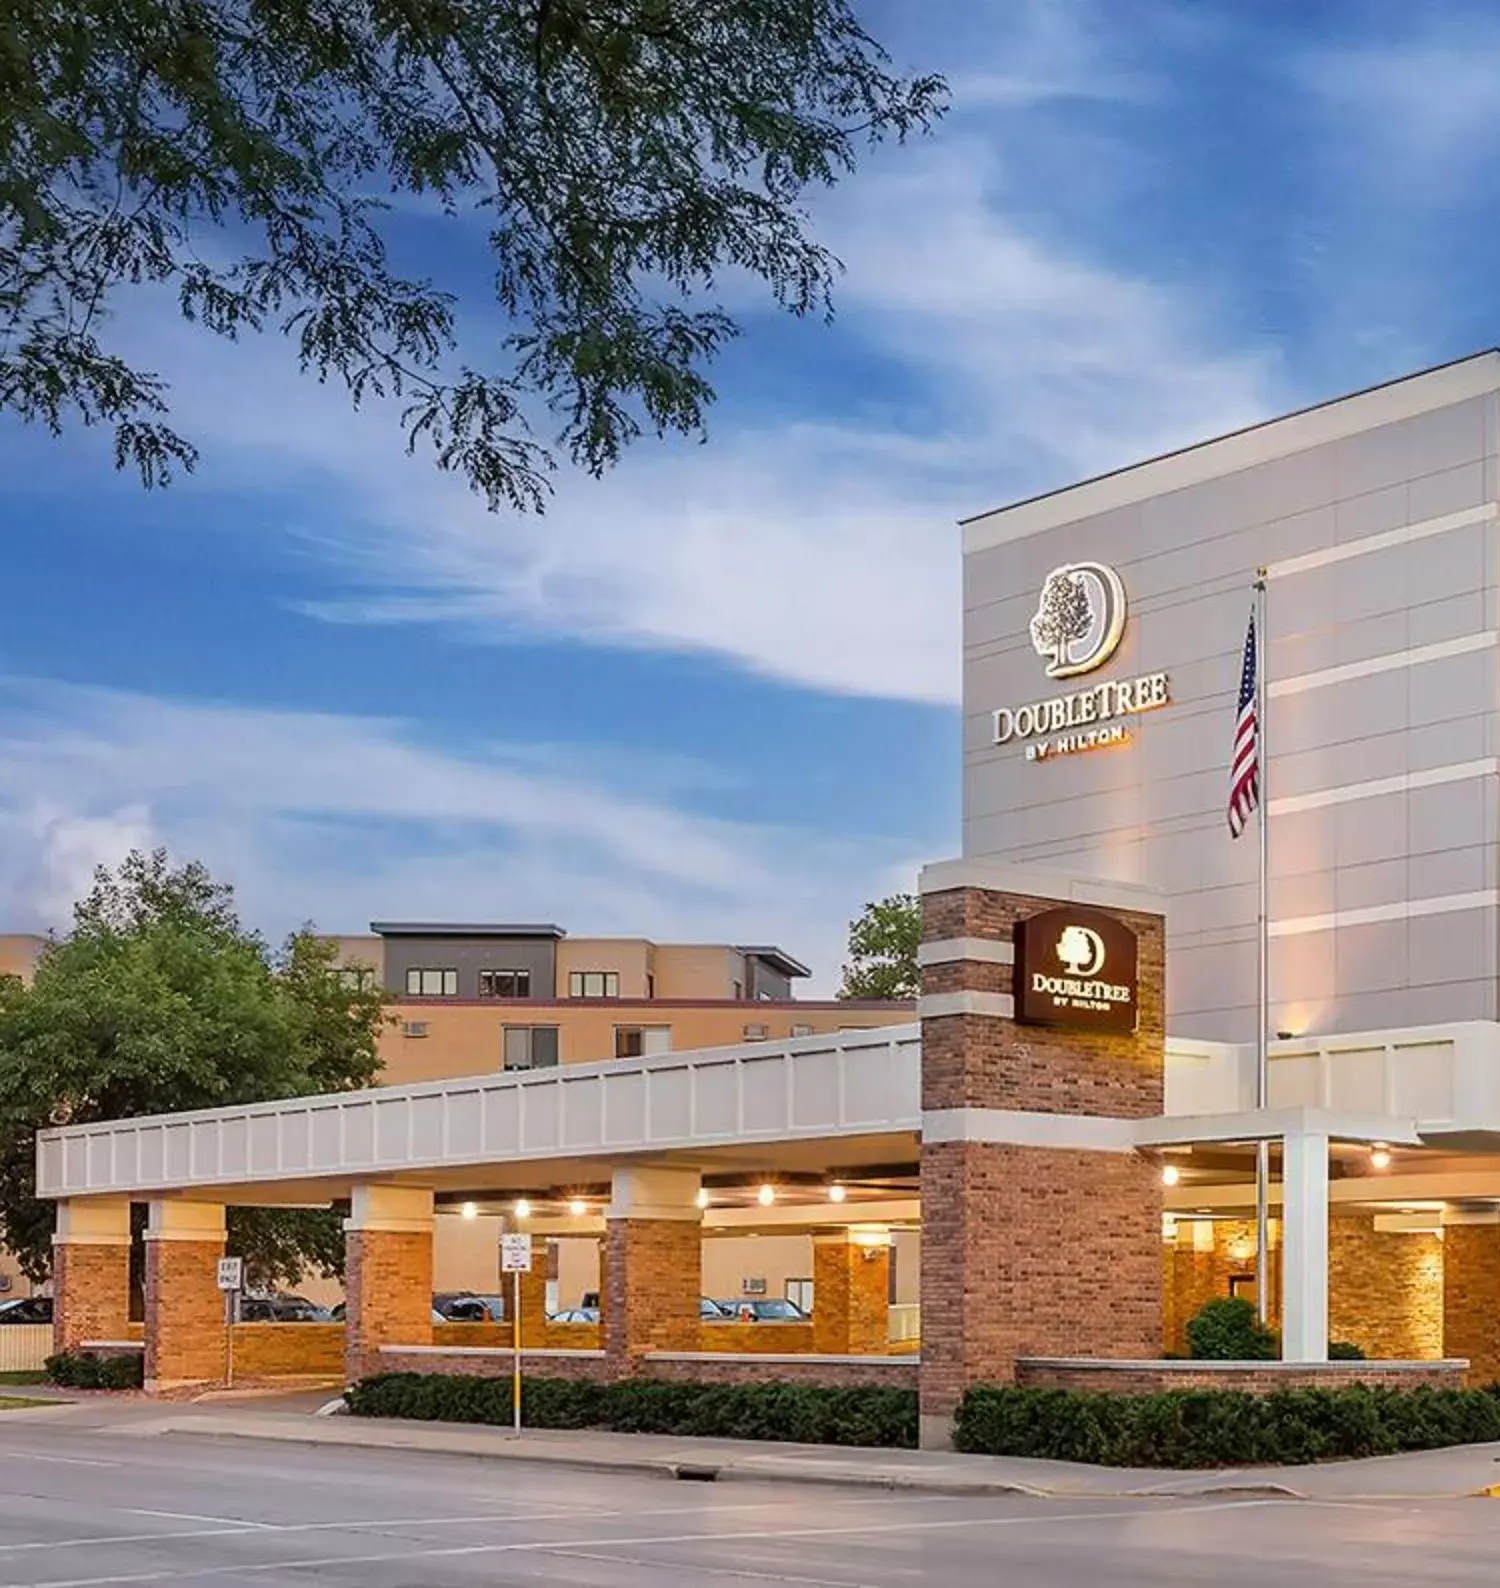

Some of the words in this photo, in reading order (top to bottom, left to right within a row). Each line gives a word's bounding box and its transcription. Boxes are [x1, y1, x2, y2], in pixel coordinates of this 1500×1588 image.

[992, 673, 1168, 743] DOUBLETREE
[1025, 743, 1049, 761] BY
[1057, 725, 1124, 753] HILTON
[1032, 973, 1131, 1003] DOUBLETREE
[1053, 996, 1069, 1006] BY
[1072, 998, 1111, 1011] HILTON
